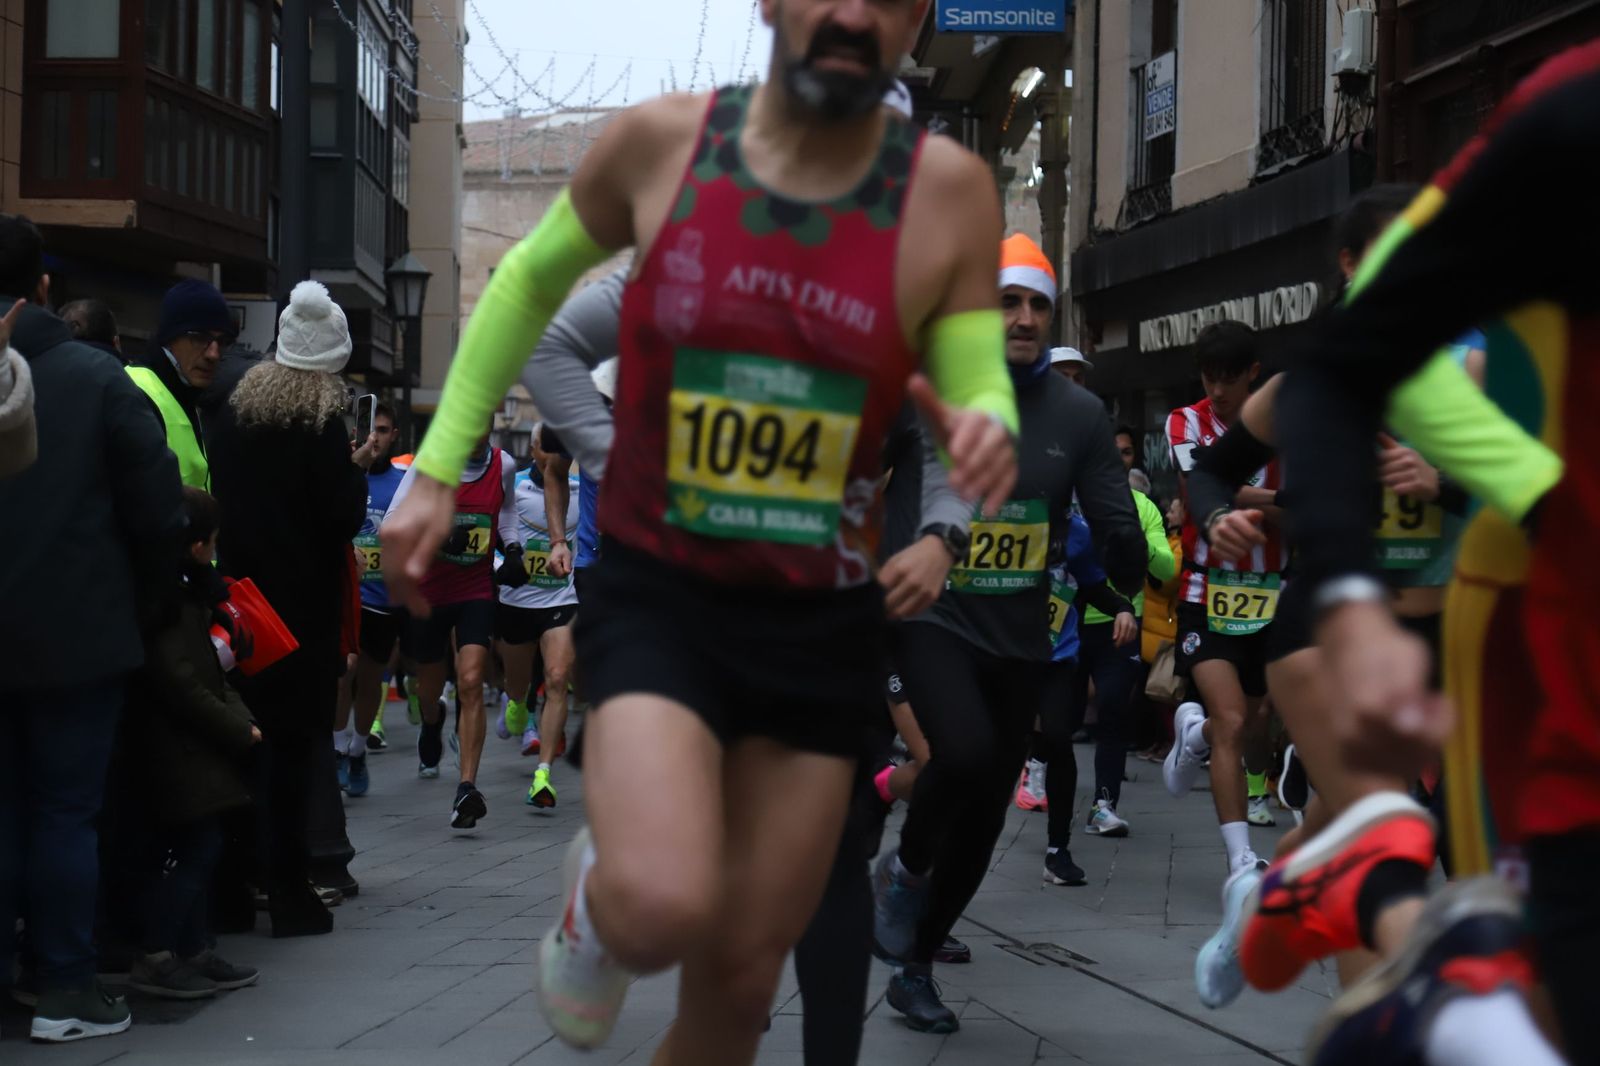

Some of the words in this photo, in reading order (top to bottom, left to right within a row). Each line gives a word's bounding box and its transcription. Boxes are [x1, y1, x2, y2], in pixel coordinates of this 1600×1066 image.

[944, 7, 1056, 26] Samsonite
[1147, 87, 1173, 114] VENDE
[723, 264, 793, 300] APIS
[799, 279, 877, 335] DURI
[1258, 281, 1318, 330] WORLD
[682, 402, 821, 483] 1094
[1143, 432, 1170, 474] SHO
[528, 556, 551, 575] 12
[1001, 576, 1038, 588] RURAL
[1212, 591, 1269, 619] 627
